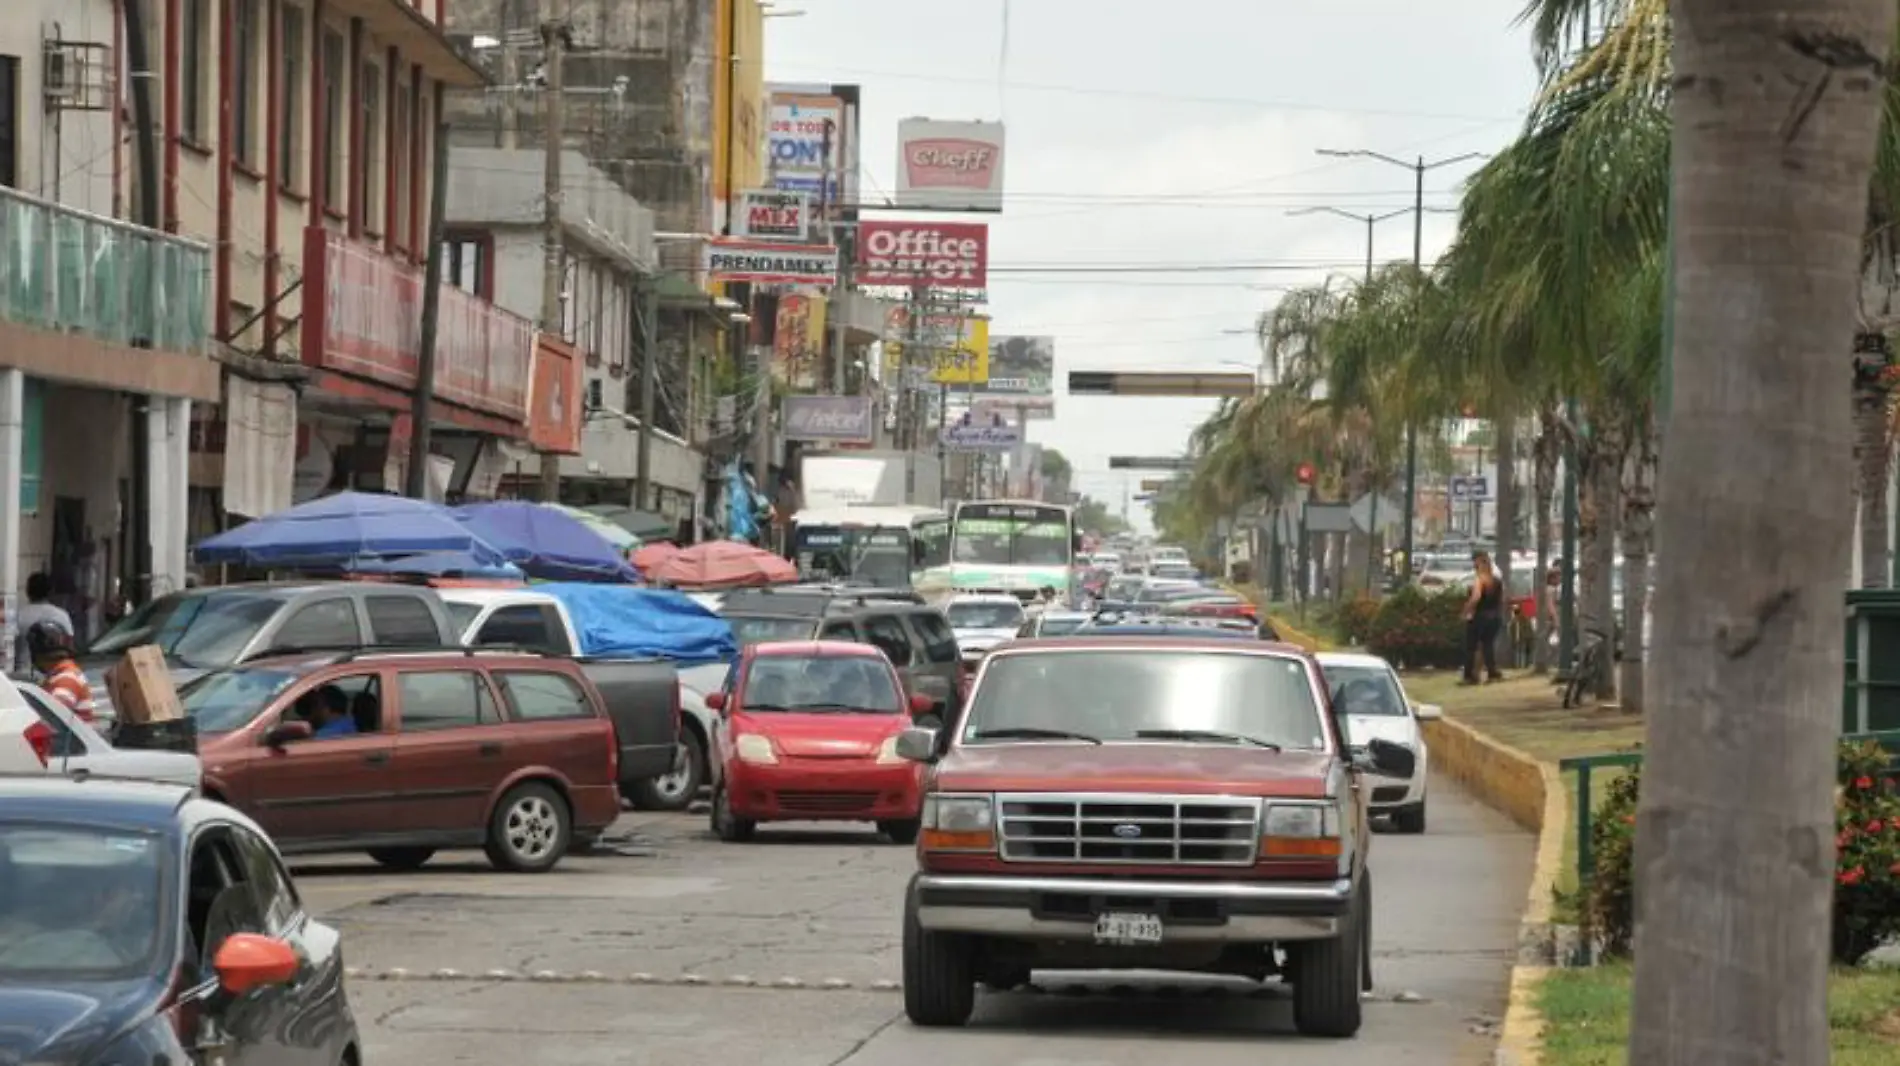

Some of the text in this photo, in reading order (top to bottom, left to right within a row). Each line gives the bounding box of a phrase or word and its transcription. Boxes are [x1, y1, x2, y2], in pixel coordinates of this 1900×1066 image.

[748, 206, 798, 226] MEX
[868, 229, 978, 257] Office
[711, 254, 826, 273] PRENDAMEX
